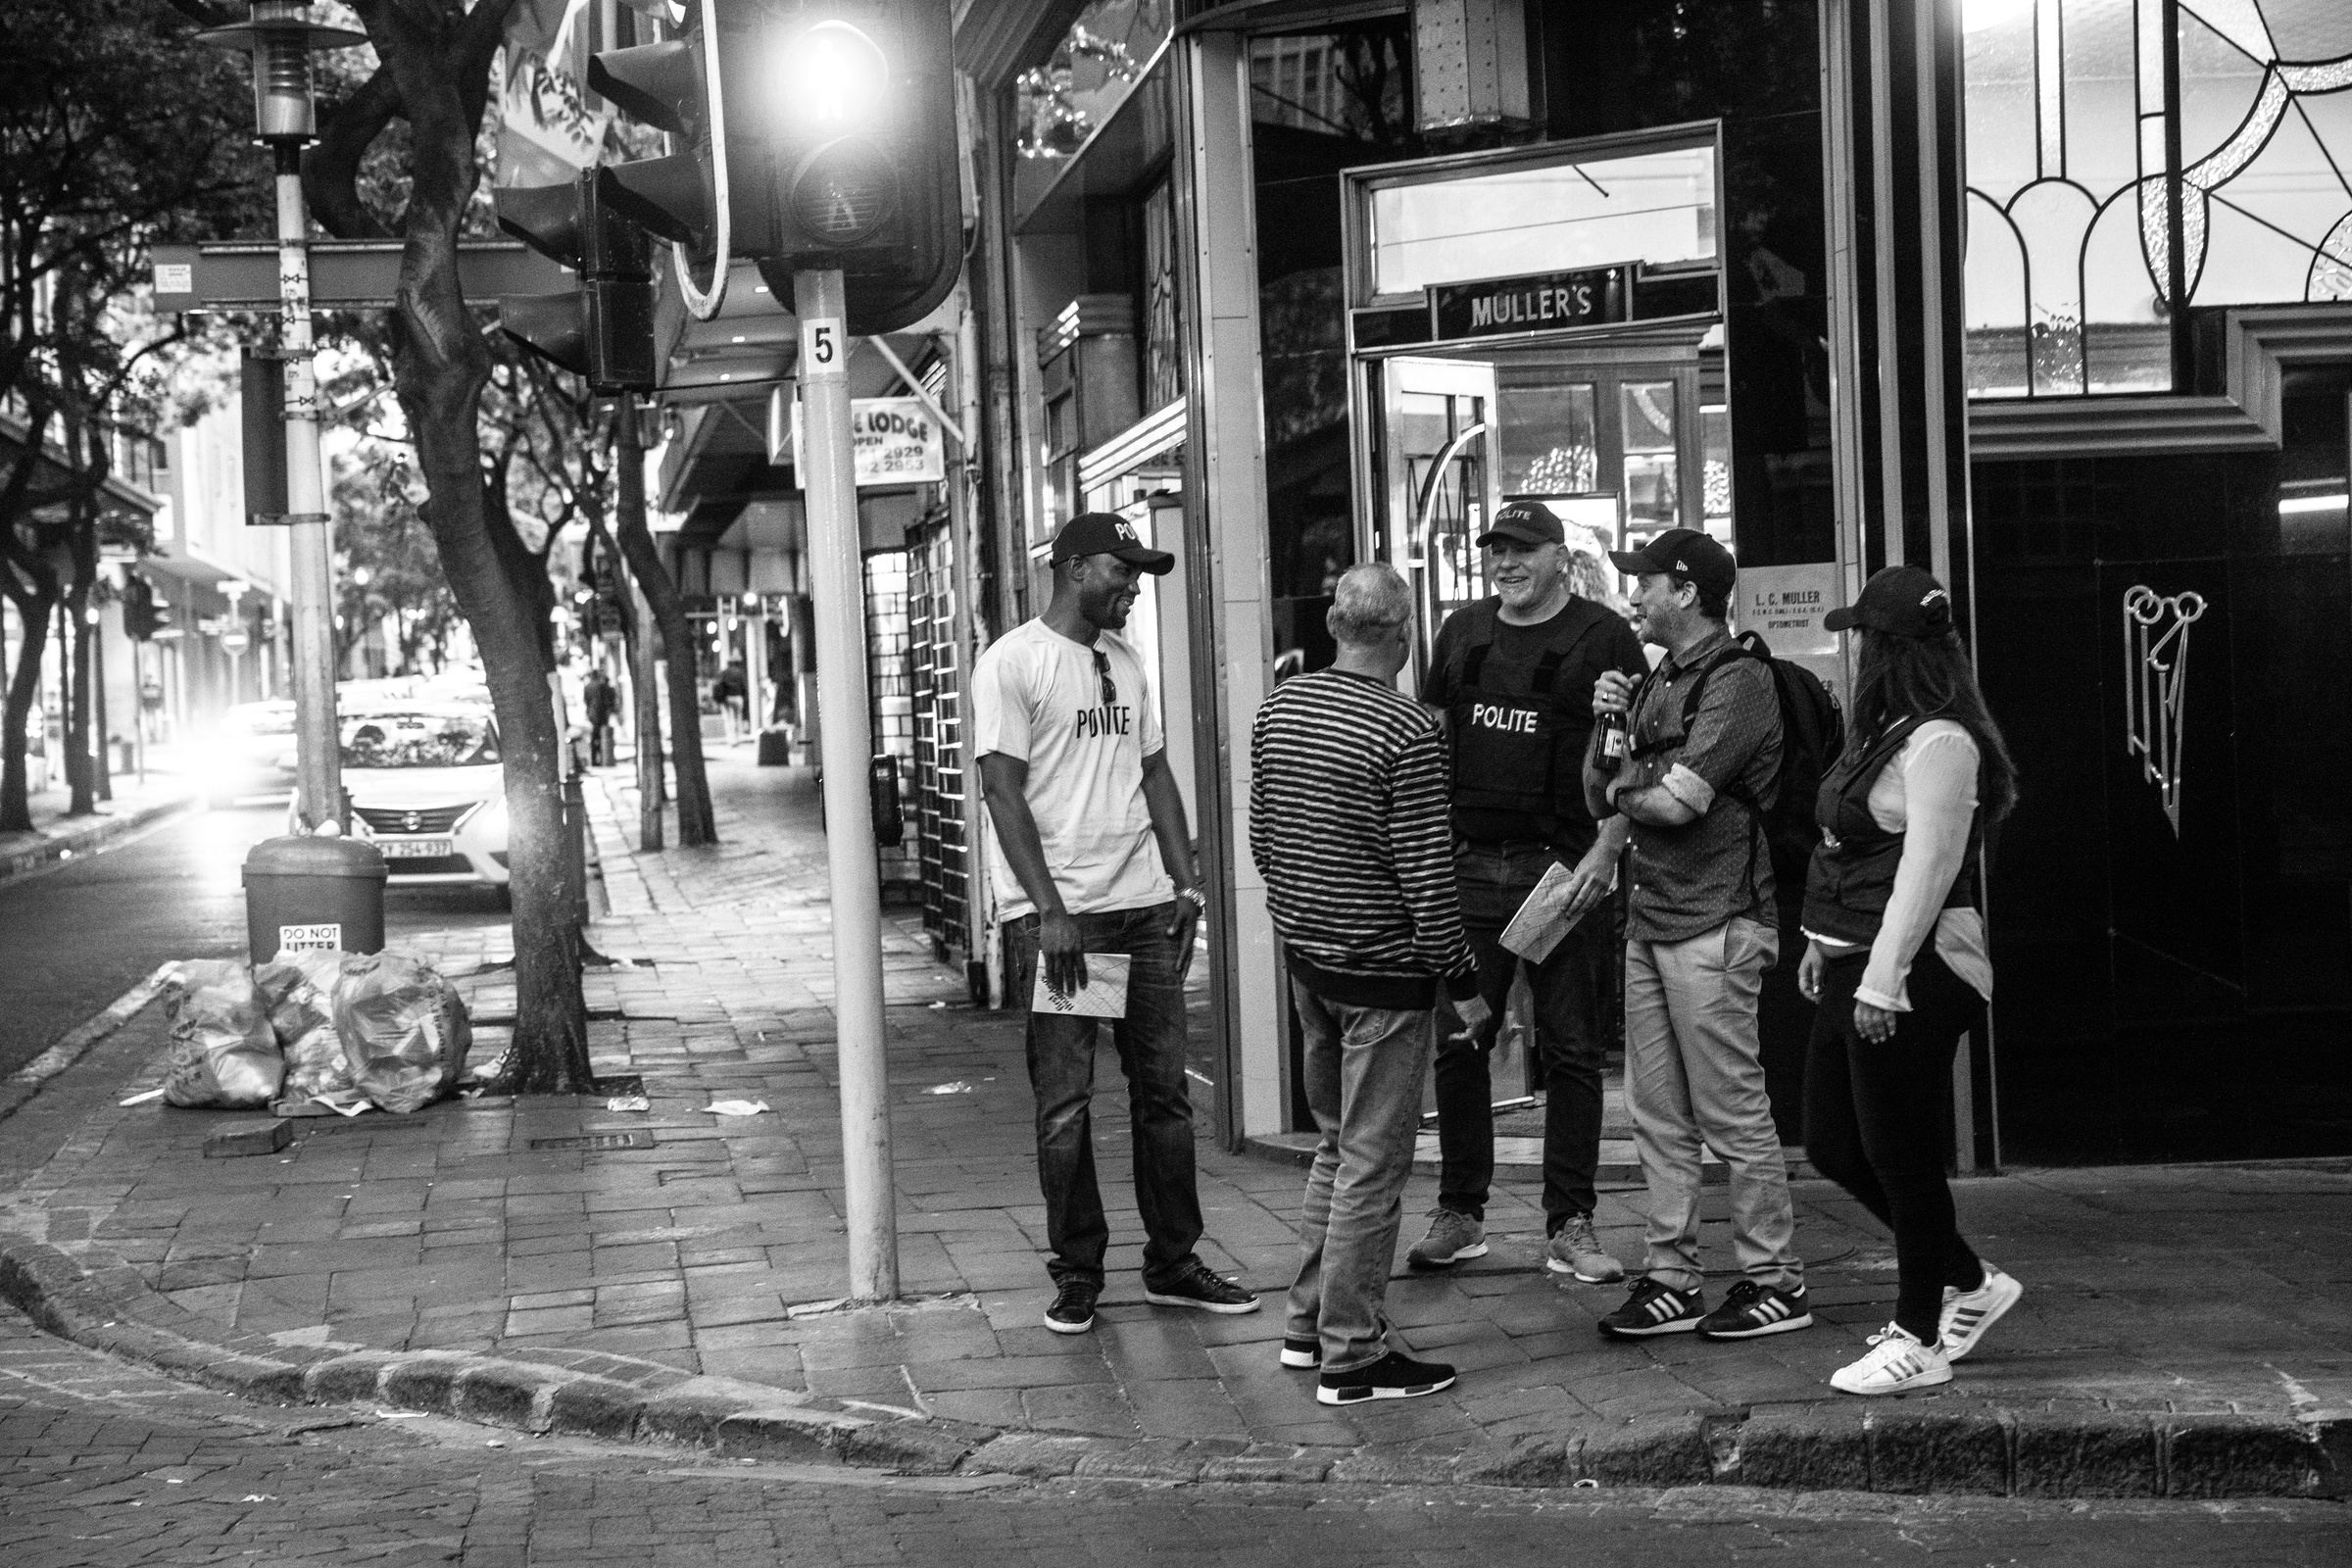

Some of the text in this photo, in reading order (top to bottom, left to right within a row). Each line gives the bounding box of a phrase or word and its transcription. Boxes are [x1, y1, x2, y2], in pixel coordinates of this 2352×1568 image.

[1471, 284, 1592, 328] MULLER'S
[815, 327, 833, 364] 5
[867, 412, 928, 443] LODGE
[1755, 590, 1820, 607] L. C. MULLER
[1471, 703, 1539, 734] POLITE
[283, 927, 337, 939] DO NOT
